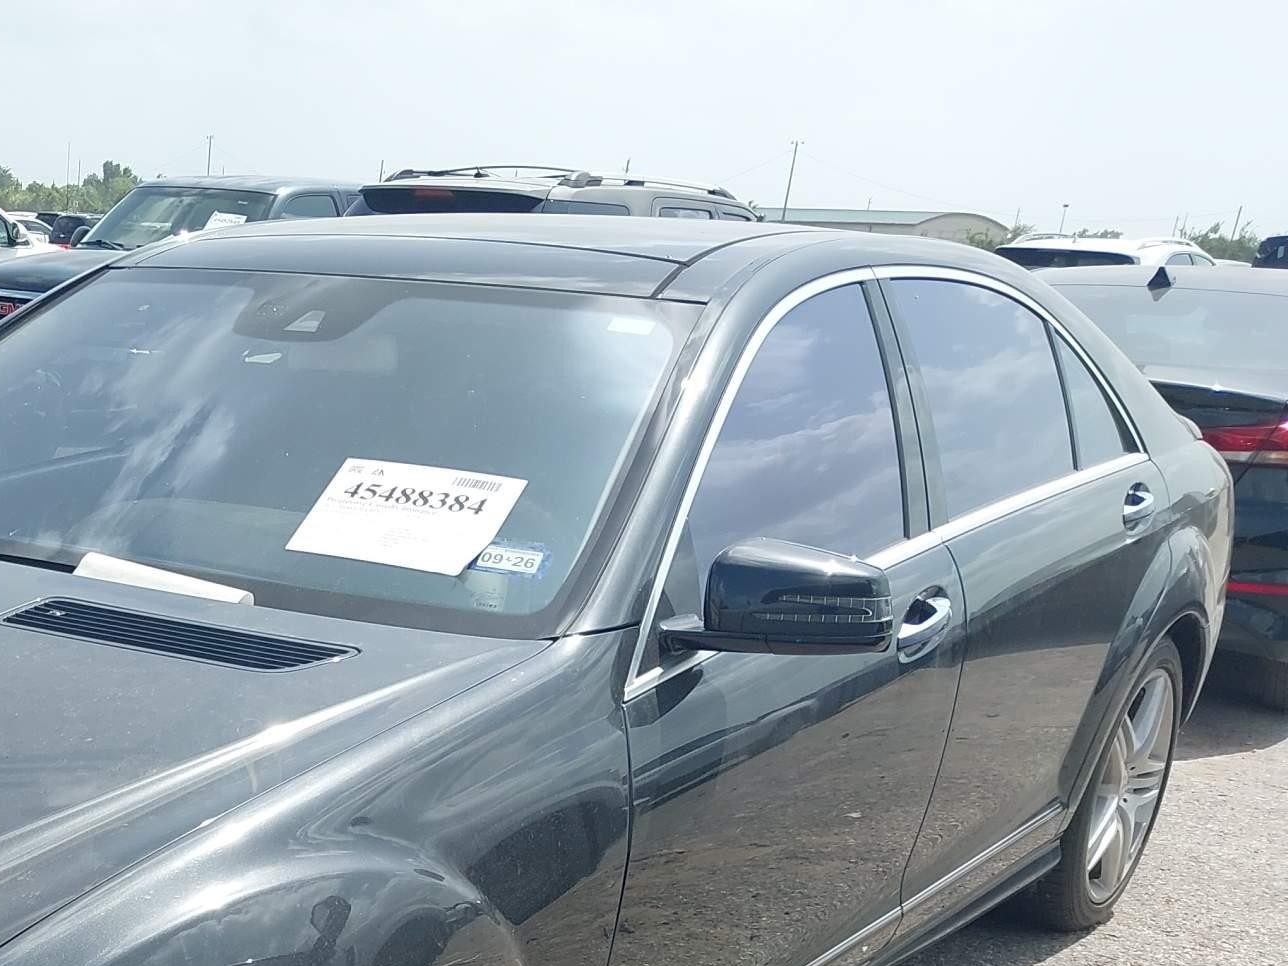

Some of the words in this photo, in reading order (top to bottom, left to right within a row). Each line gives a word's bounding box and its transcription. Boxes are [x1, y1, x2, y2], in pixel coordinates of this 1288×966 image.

[344, 481, 488, 515] 45488384
[480, 552, 504, 564] 09
[511, 556, 536, 569] 26
